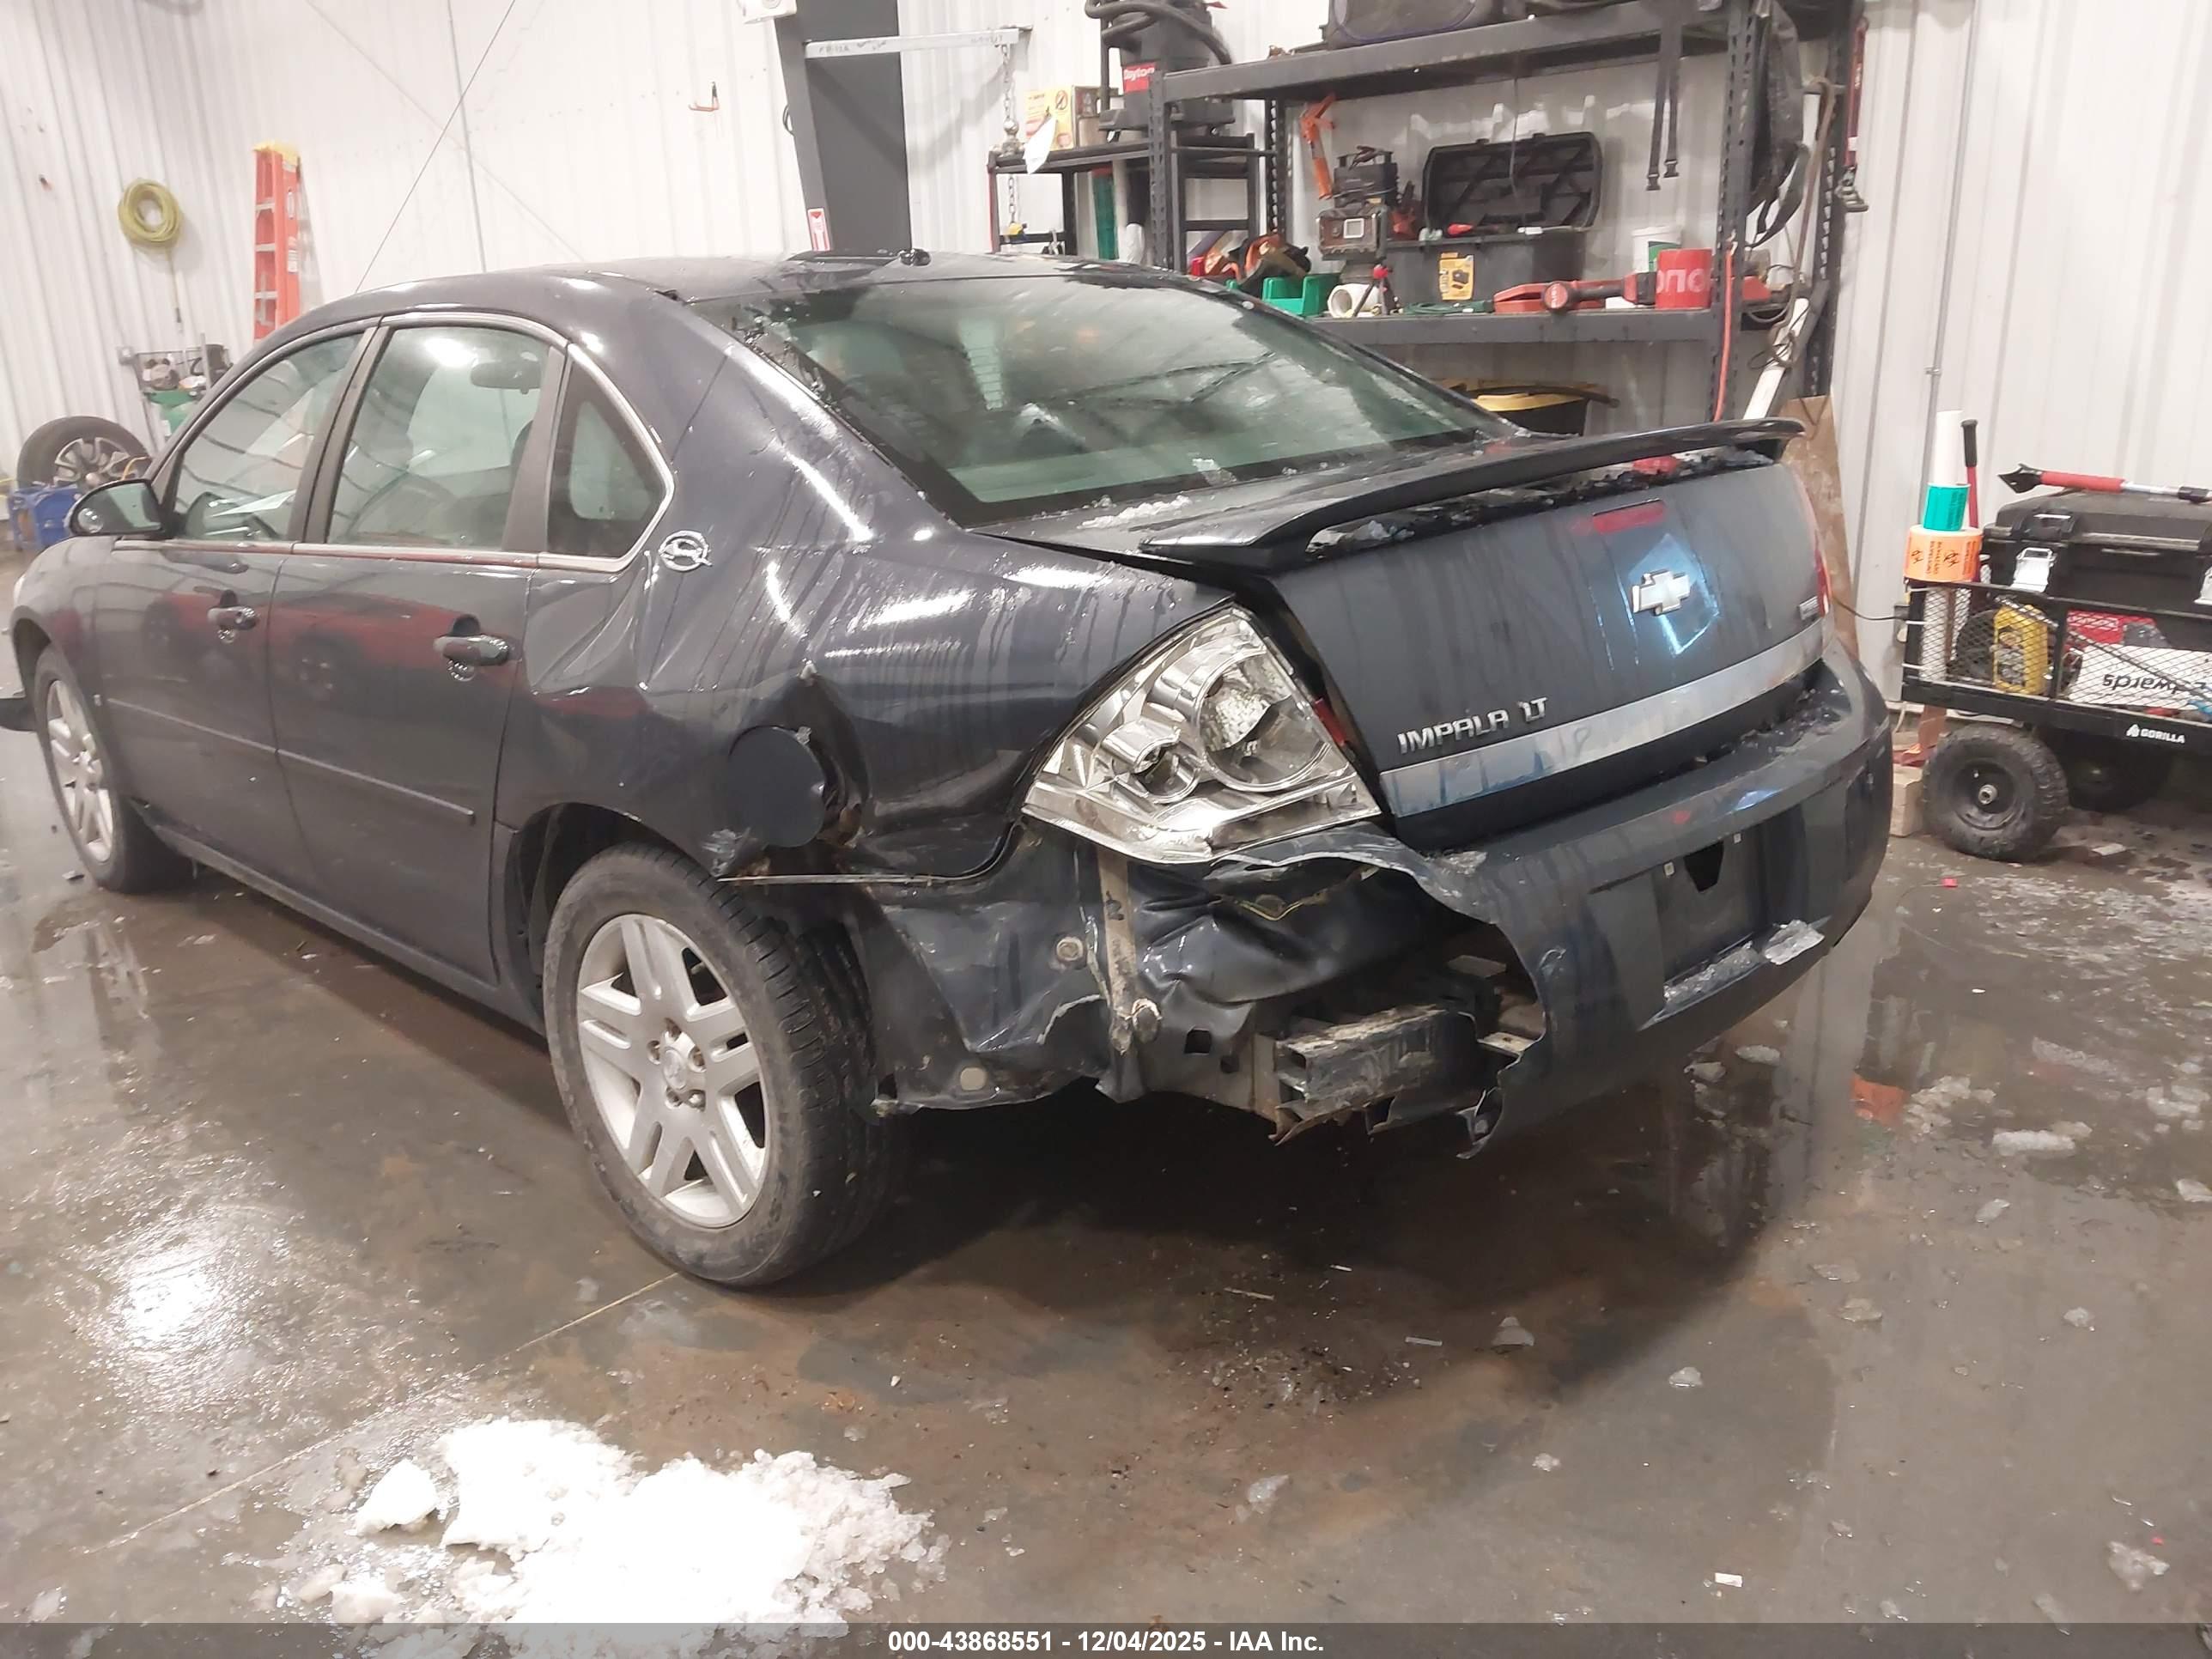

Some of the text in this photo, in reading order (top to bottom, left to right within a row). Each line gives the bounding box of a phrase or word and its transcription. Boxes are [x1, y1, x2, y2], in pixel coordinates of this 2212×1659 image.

[1397, 696, 1547, 754] IMPALA LT
[2140, 728, 2185, 744] GORILLA
